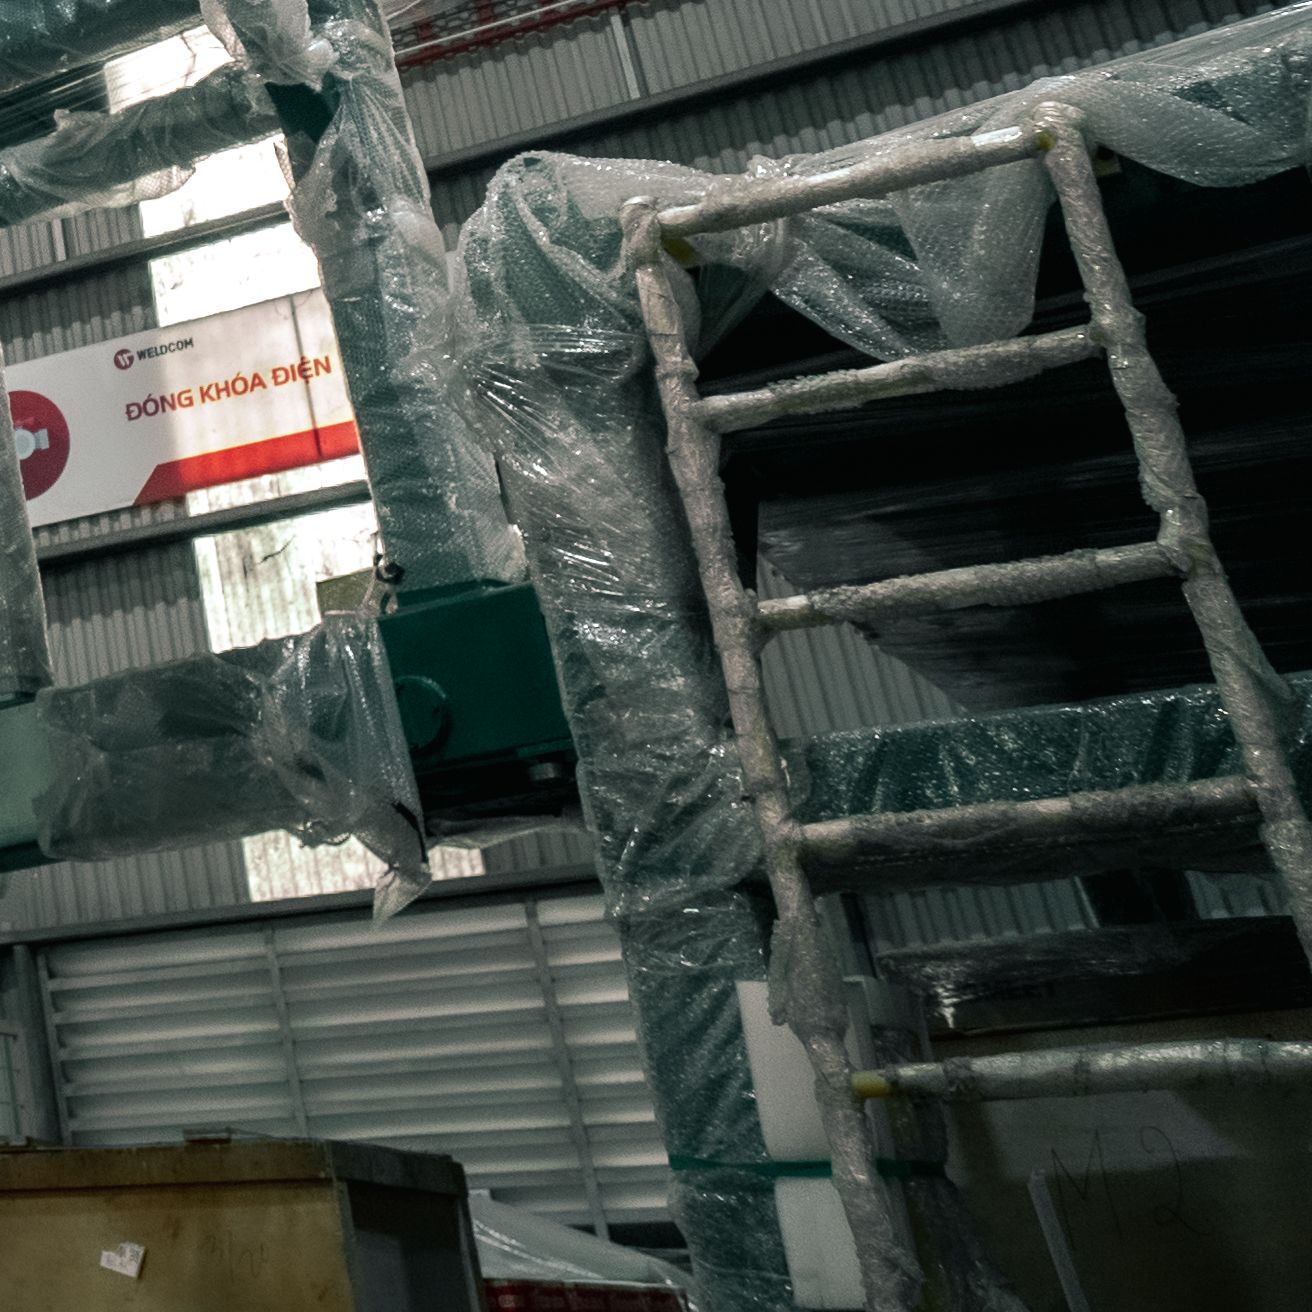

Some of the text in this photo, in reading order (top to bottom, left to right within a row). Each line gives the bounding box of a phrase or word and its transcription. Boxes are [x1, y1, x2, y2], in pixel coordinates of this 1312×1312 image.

[137, 337, 194, 361] WELDCOM
[125, 388, 194, 422] ĐÓNG
[199, 371, 267, 404] KHÓA
